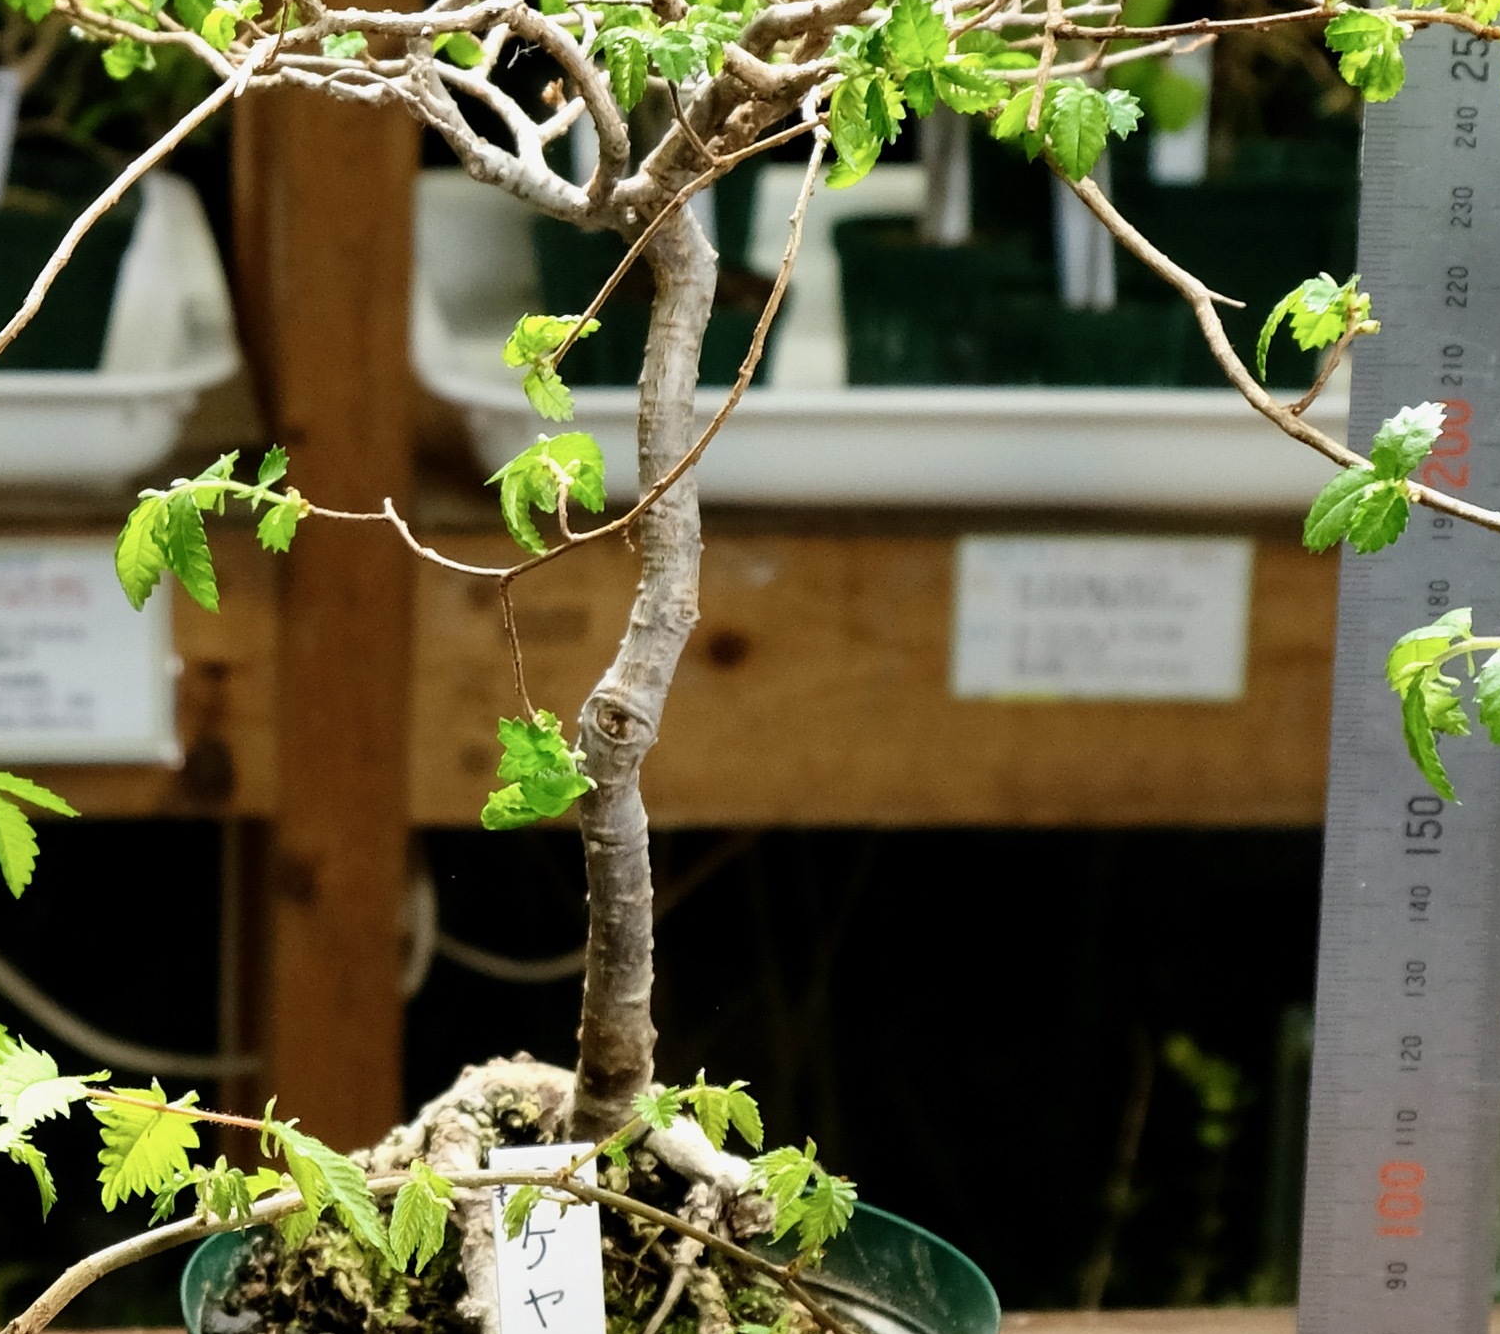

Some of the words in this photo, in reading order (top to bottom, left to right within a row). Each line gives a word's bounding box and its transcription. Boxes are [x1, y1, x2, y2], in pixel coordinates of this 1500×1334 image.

[1451, 28, 1490, 83] 25
[1455, 106, 1478, 149] 240
[1450, 186, 1474, 229] 230
[1446, 266, 1469, 308] 220
[1441, 343, 1464, 387] 210
[1421, 399, 1473, 489] 200
[1405, 795, 1444, 855] 150
[1409, 885, 1432, 922] 140
[1404, 960, 1427, 997] 130
[1400, 1035, 1423, 1072] 120
[1396, 1109, 1418, 1146] 110
[1376, 1160, 1427, 1237] 100
[1386, 1261, 1408, 1290] 90
